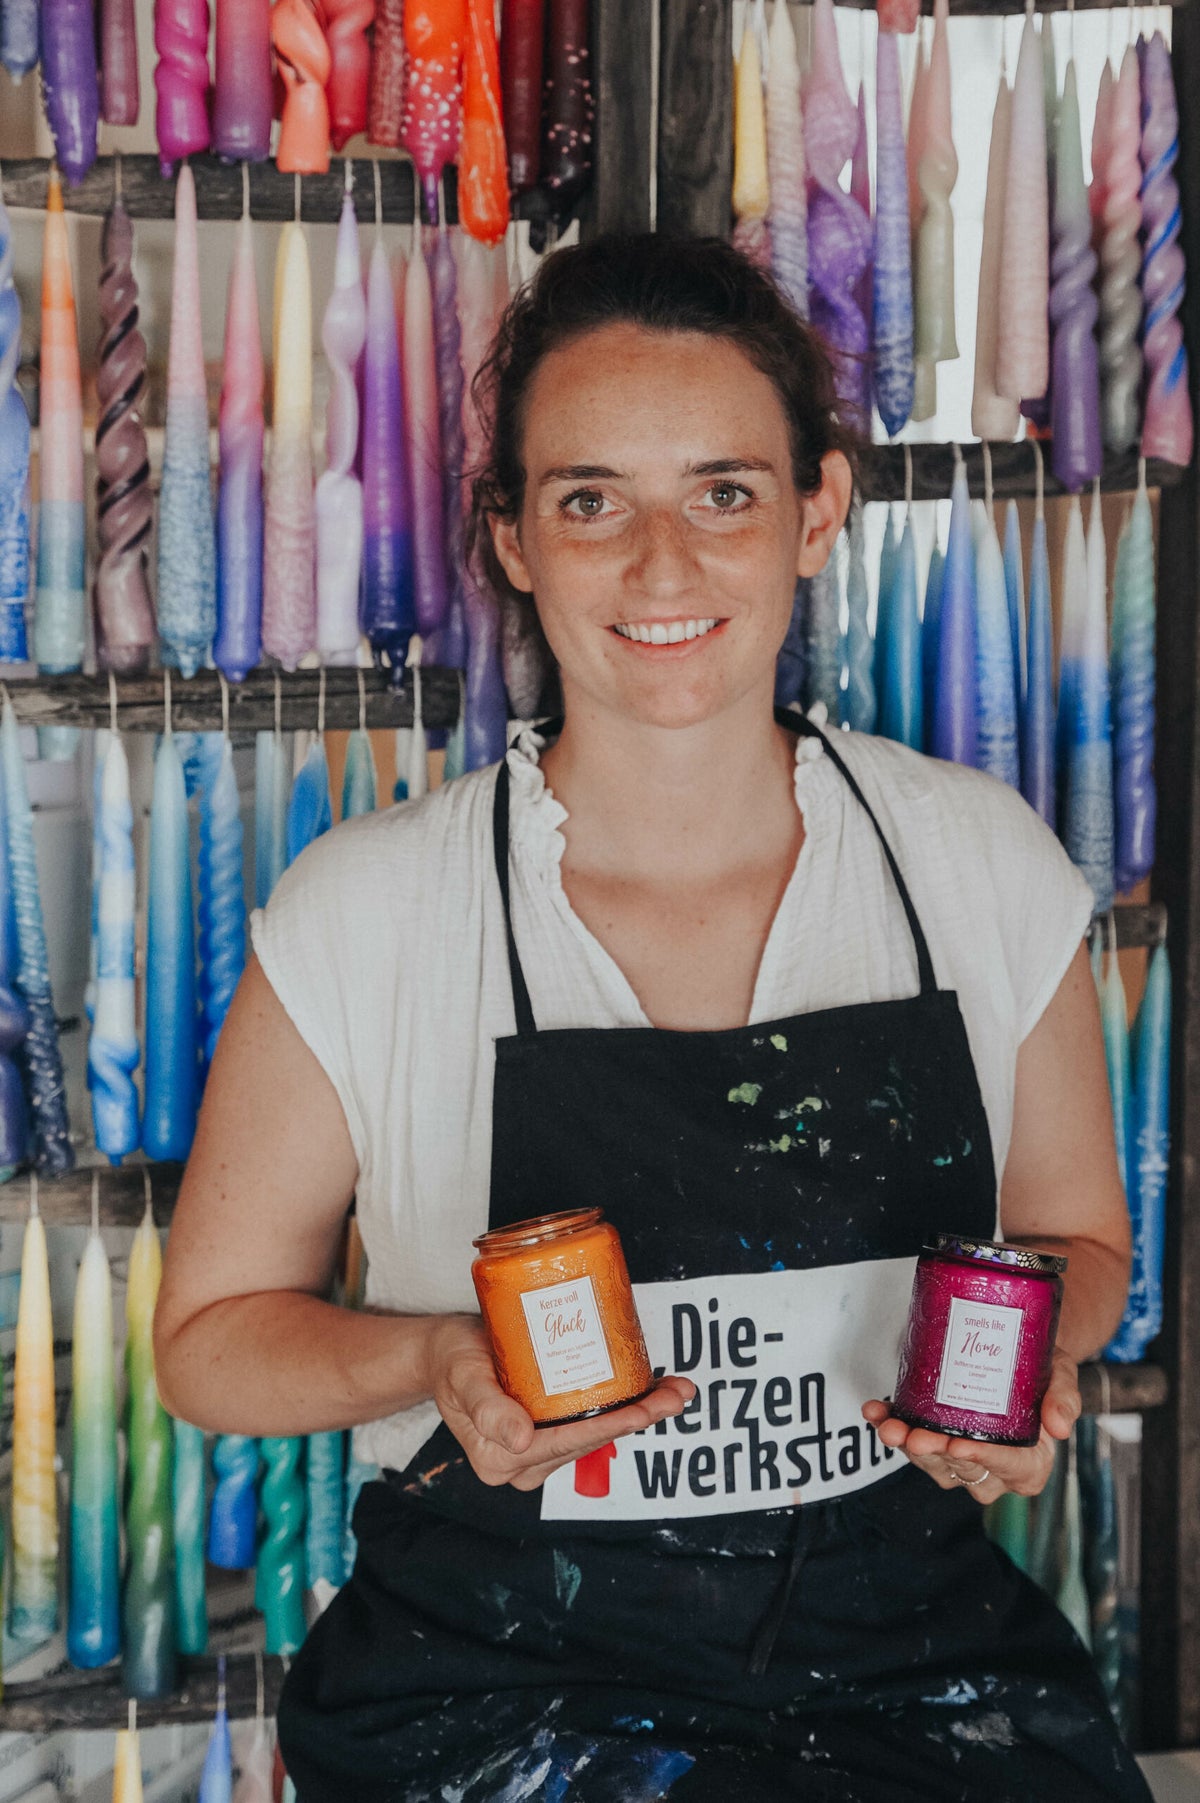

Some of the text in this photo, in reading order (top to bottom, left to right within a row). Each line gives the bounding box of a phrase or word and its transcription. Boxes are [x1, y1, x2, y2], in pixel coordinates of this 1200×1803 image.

[539, 1291, 579, 1311] Kerze voll
[671, 1297, 785, 1373] Die-
[964, 1317, 1006, 1331] smells like
[635, 1366, 825, 1436] erzen
